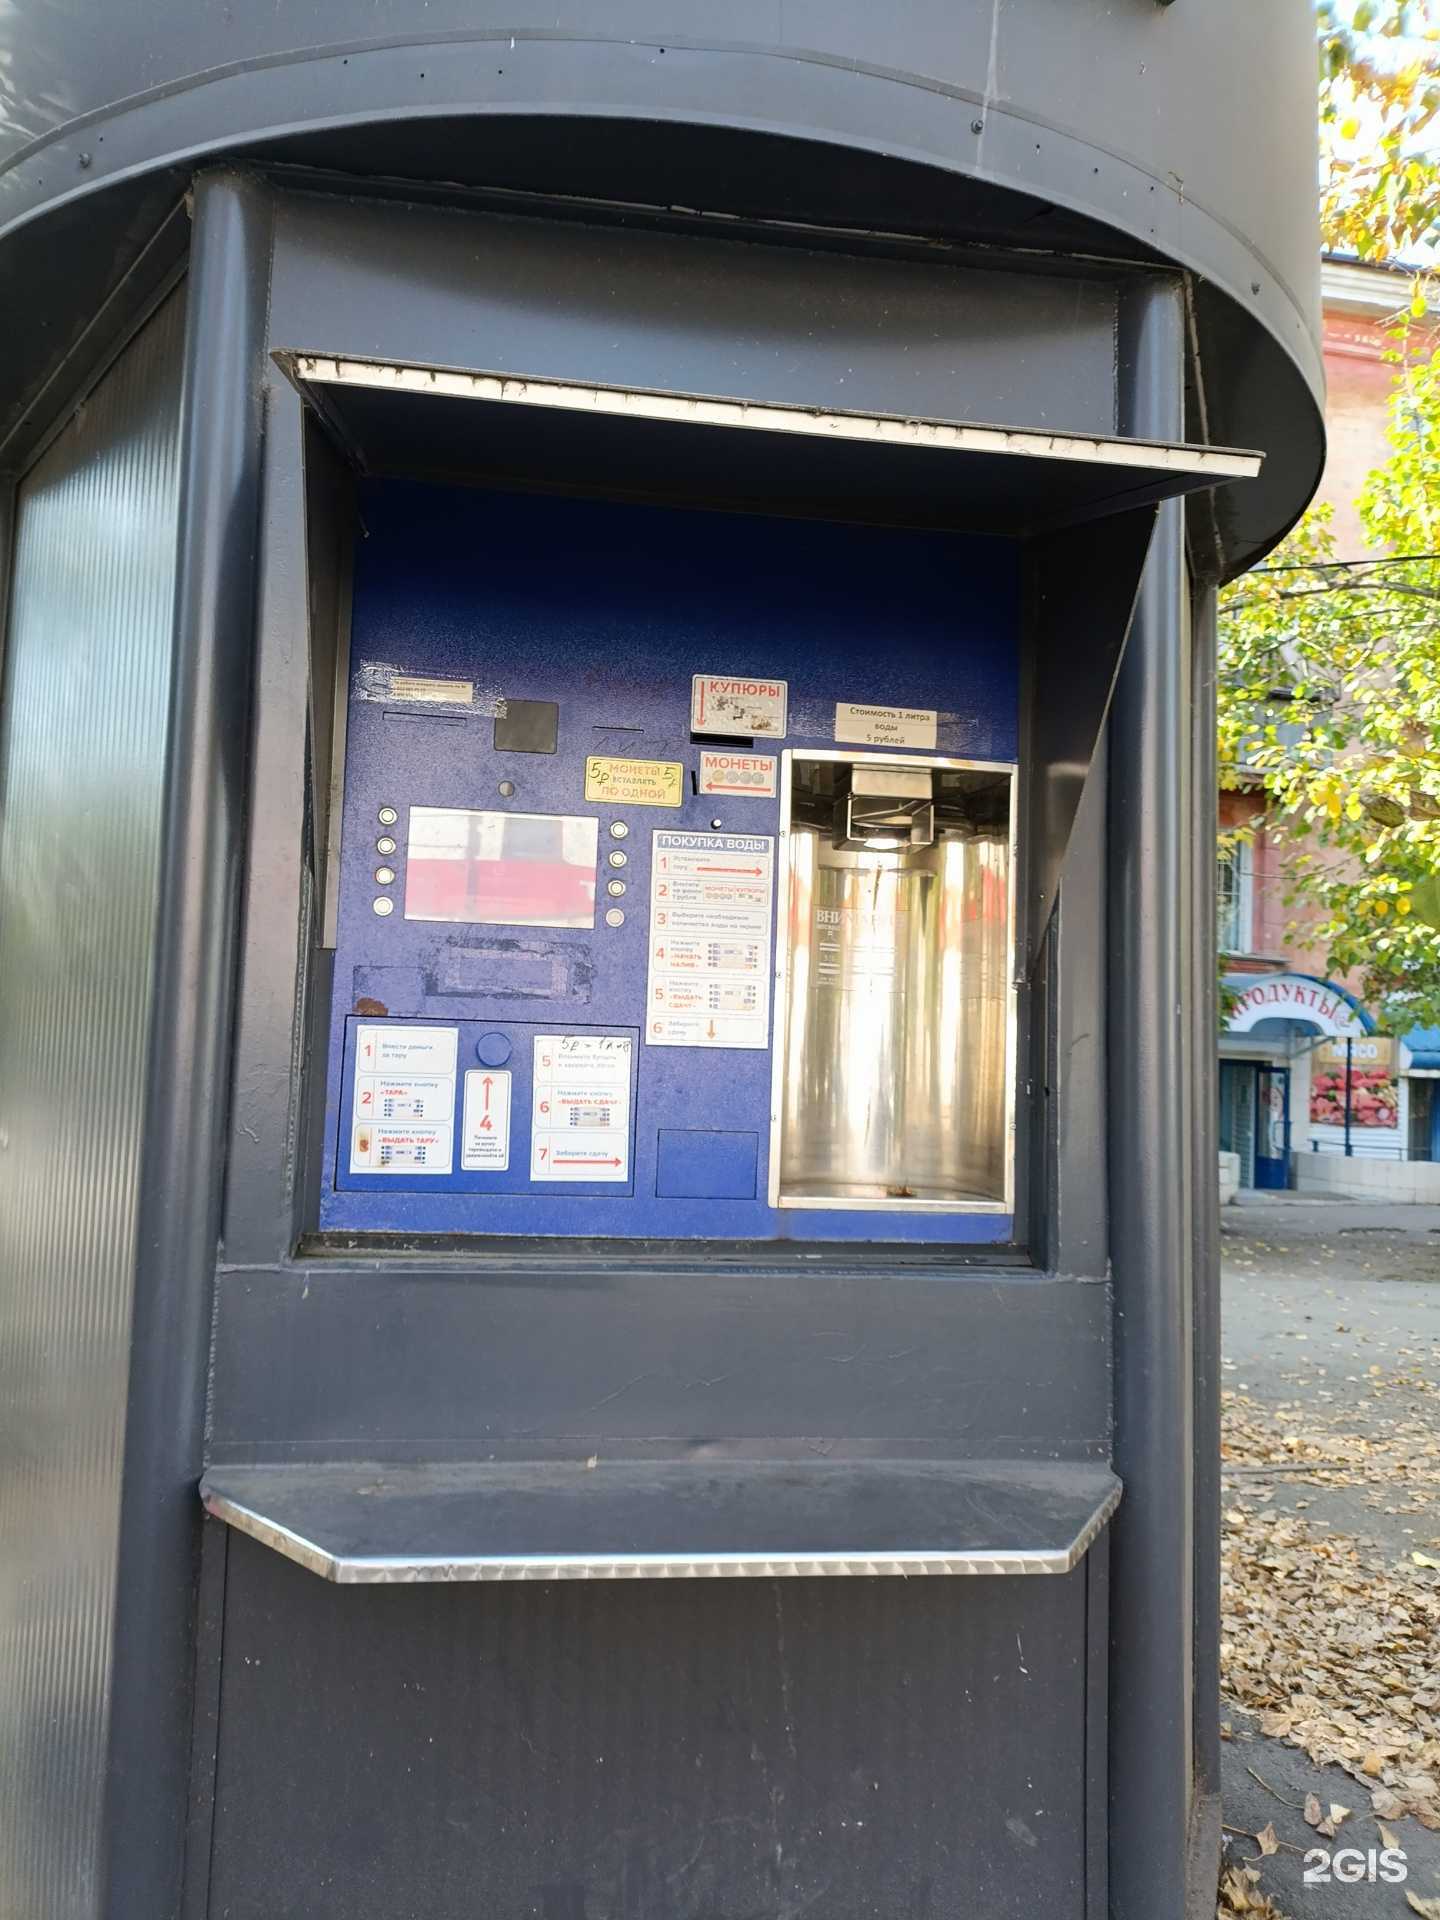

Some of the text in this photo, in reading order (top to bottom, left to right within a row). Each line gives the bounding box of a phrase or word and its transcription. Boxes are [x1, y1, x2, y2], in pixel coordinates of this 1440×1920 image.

[709, 681, 781, 697] КУПЮРЫ
[849, 706, 931, 722] Стоимость 1 литра
[874, 723, 898, 732] воды
[866, 733, 905, 745] 5 рублей
[609, 763, 661, 777] МОНЕТЫ
[705, 757, 773, 771] МОНЕТЫ
[612, 777, 657, 786] ВСТАВЛЯТЬ
[601, 786, 666, 800] ПО ОДНОЙ
[662, 835, 766, 851] ПОКУПКА ВОДЫ
[659, 857, 667, 869] 1
[658, 884, 668, 897] 2
[657, 912, 666, 925] 3
[655, 947, 665, 959] 4
[655, 987, 664, 1000] 5
[652, 1021, 663, 1034] 6
[364, 1044, 372, 1057] 1
[542, 1055, 551, 1067] 5
[362, 1091, 372, 1105] 2
[539, 1100, 550, 1113] 6
[479, 1114, 492, 1131] 4
[538, 1148, 548, 1161] 7
